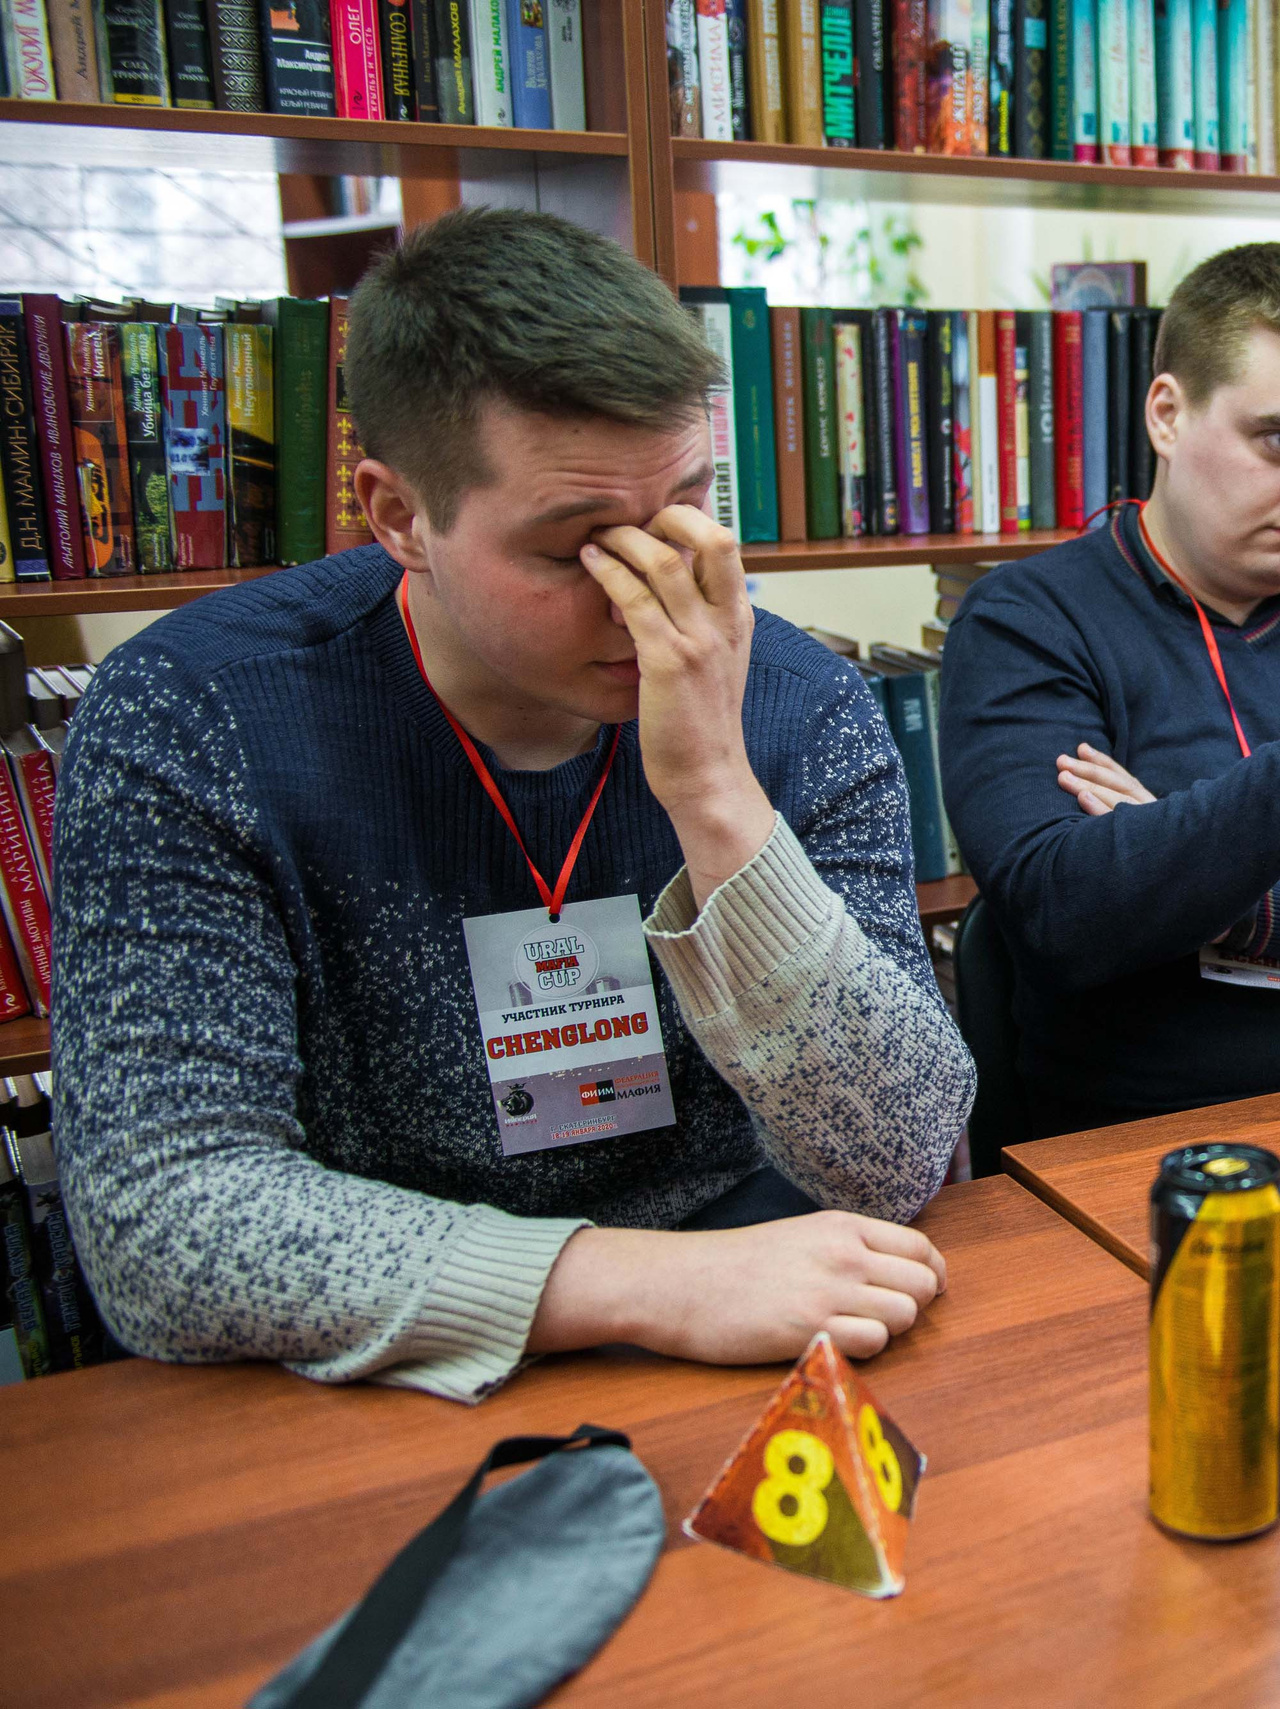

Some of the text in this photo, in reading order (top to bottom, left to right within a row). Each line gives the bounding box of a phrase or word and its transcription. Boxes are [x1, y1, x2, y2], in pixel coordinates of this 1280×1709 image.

[347, 4, 362, 45] ОЛЕГ
[389, 12, 411, 97] СОЛНЕЧНАЯ
[365, 28, 378, 112] КРЫЛЬЯ И ЧЕСТЬ
[492, 51, 504, 93] АНДРЕЙ
[822, 17, 854, 138] МИТЧЕЛЛ
[82, 332, 96, 412] Хеннинг Манкелль
[92, 332, 104, 378] Китаец
[129, 332, 142, 412] Хеннинг Манкелль
[138, 333, 155, 438] Убийца без лица
[198, 335, 209, 417] Хеннинг Манкелль
[208, 335, 217, 391] Глухая стена
[242, 334, 254, 417] Неугомонный
[33, 315, 74, 569] АНАТОЛИЙ МАНАХОВ ИВАНОВСКИЕ ДВОРИКИ
[20, 899, 52, 985] ЛИЧНЫЕ МОТИВЫ
[524, 936, 584, 961] URAL
[535, 955, 579, 974] MAFIA
[538, 968, 581, 990] CUP
[486, 1012, 649, 1059] CHENGLONG
[502, 994, 625, 1023] УЧАСТНИК ТУРНИРА
[617, 1084, 661, 1100] МАФИЯ
[752, 1429, 834, 1546] 8
[858, 1403, 902, 1513] 8
